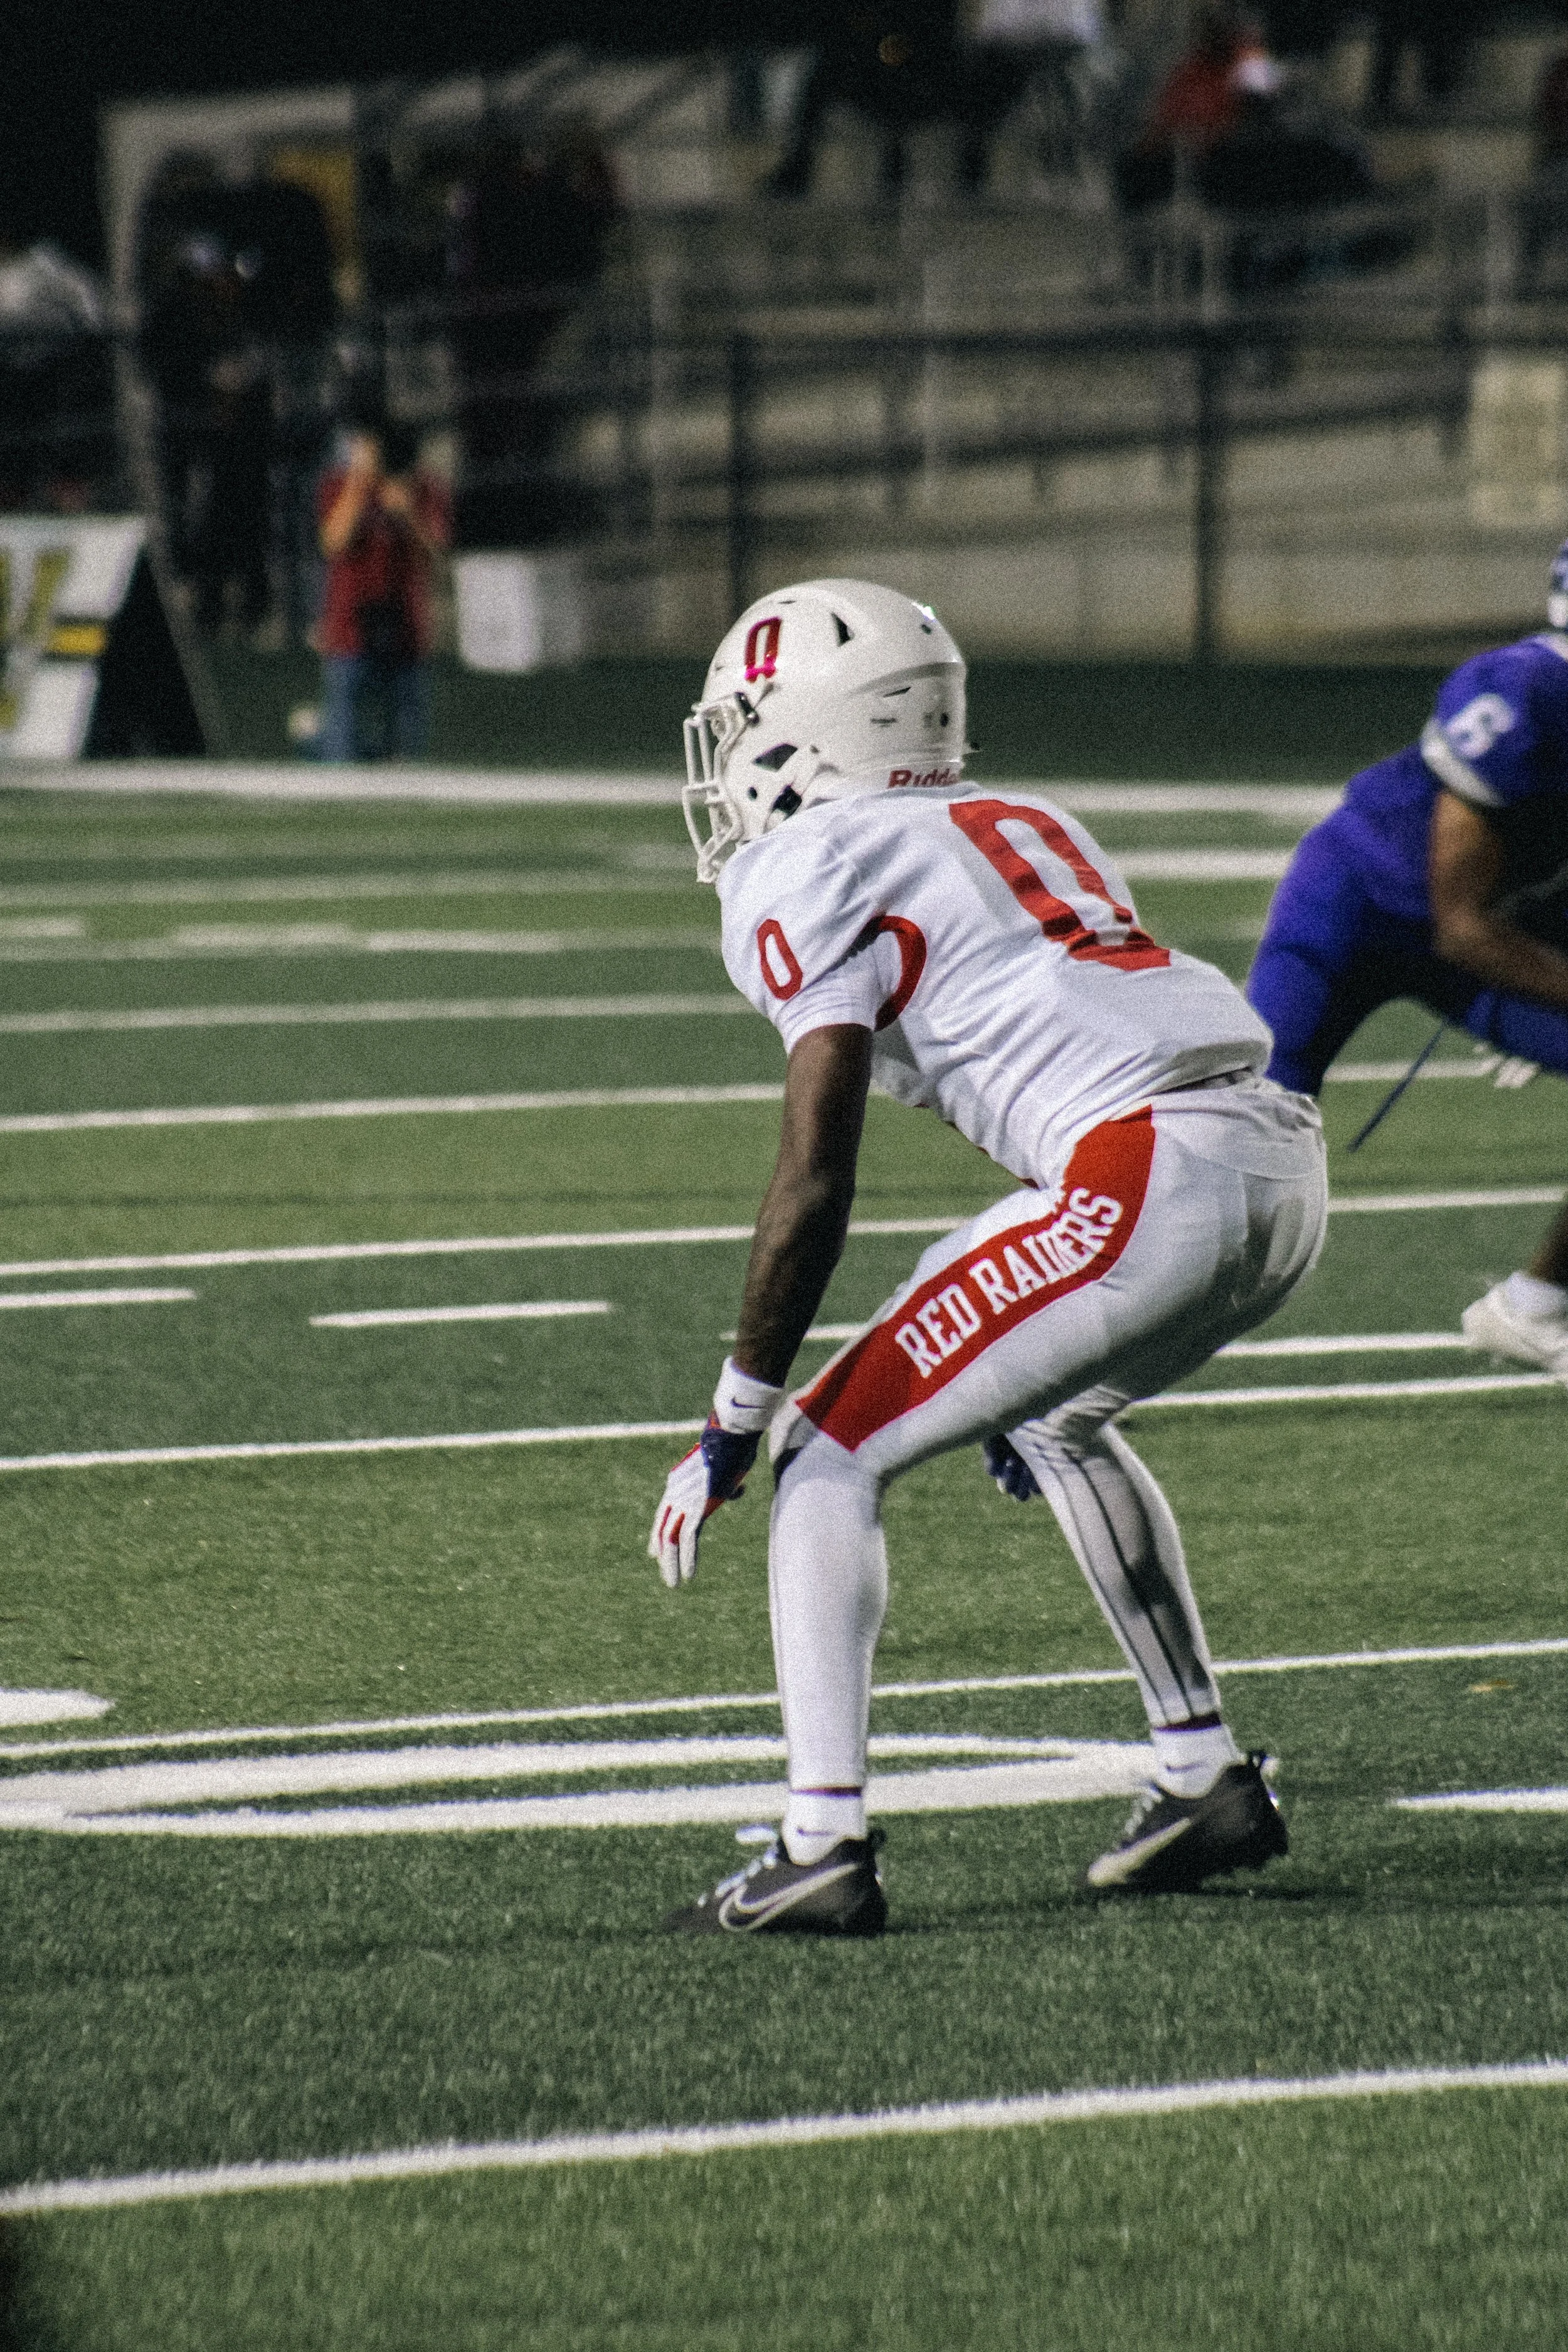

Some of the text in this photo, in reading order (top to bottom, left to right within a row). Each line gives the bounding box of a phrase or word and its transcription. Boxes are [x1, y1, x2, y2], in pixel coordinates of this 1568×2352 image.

[757, 918, 803, 1001] 0
[948, 798, 1171, 972] 0
[895, 1187, 1123, 1379] RED RAIDERS
